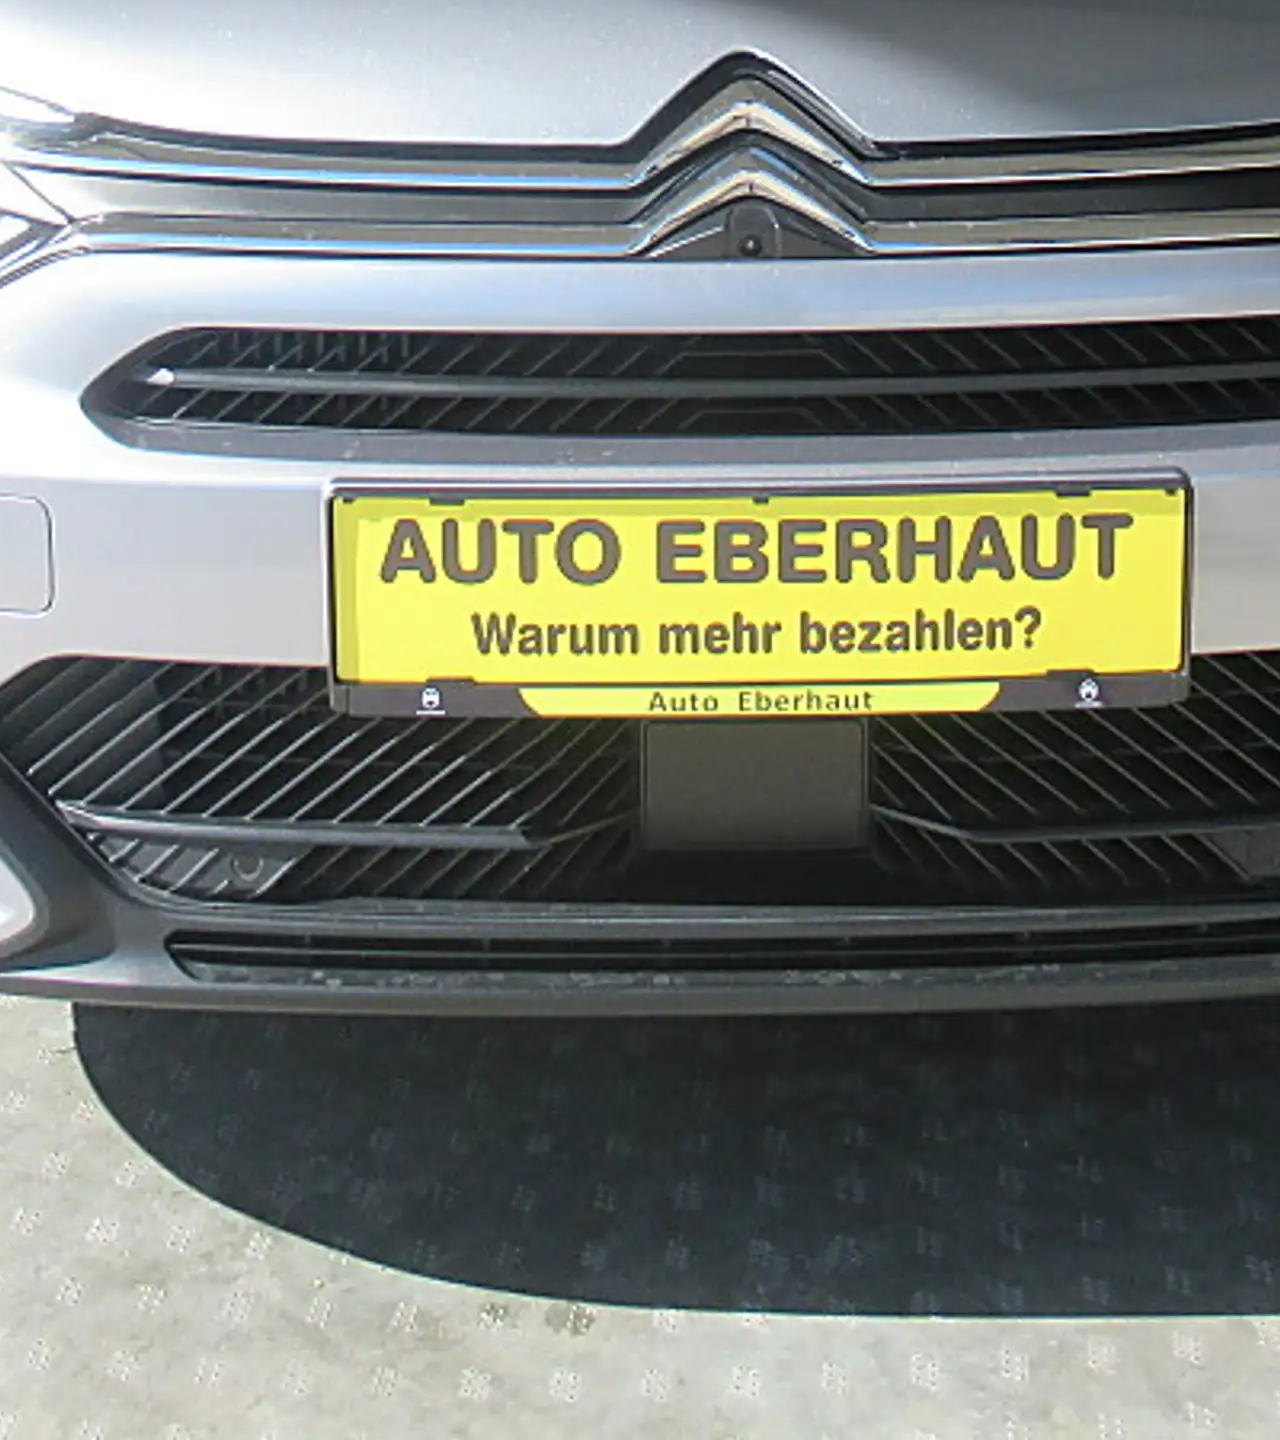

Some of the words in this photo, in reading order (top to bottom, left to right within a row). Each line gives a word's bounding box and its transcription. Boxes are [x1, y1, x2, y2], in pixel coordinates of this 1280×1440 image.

[380, 518, 622, 585] AUTO
[656, 513, 1134, 584] EBERHAUT
[471, 611, 639, 656] Warum
[659, 611, 782, 655] mehr
[800, 606, 1042, 654] bezahlen?
[648, 691, 719, 712] Auto
[738, 690, 873, 712] Eberhaut
